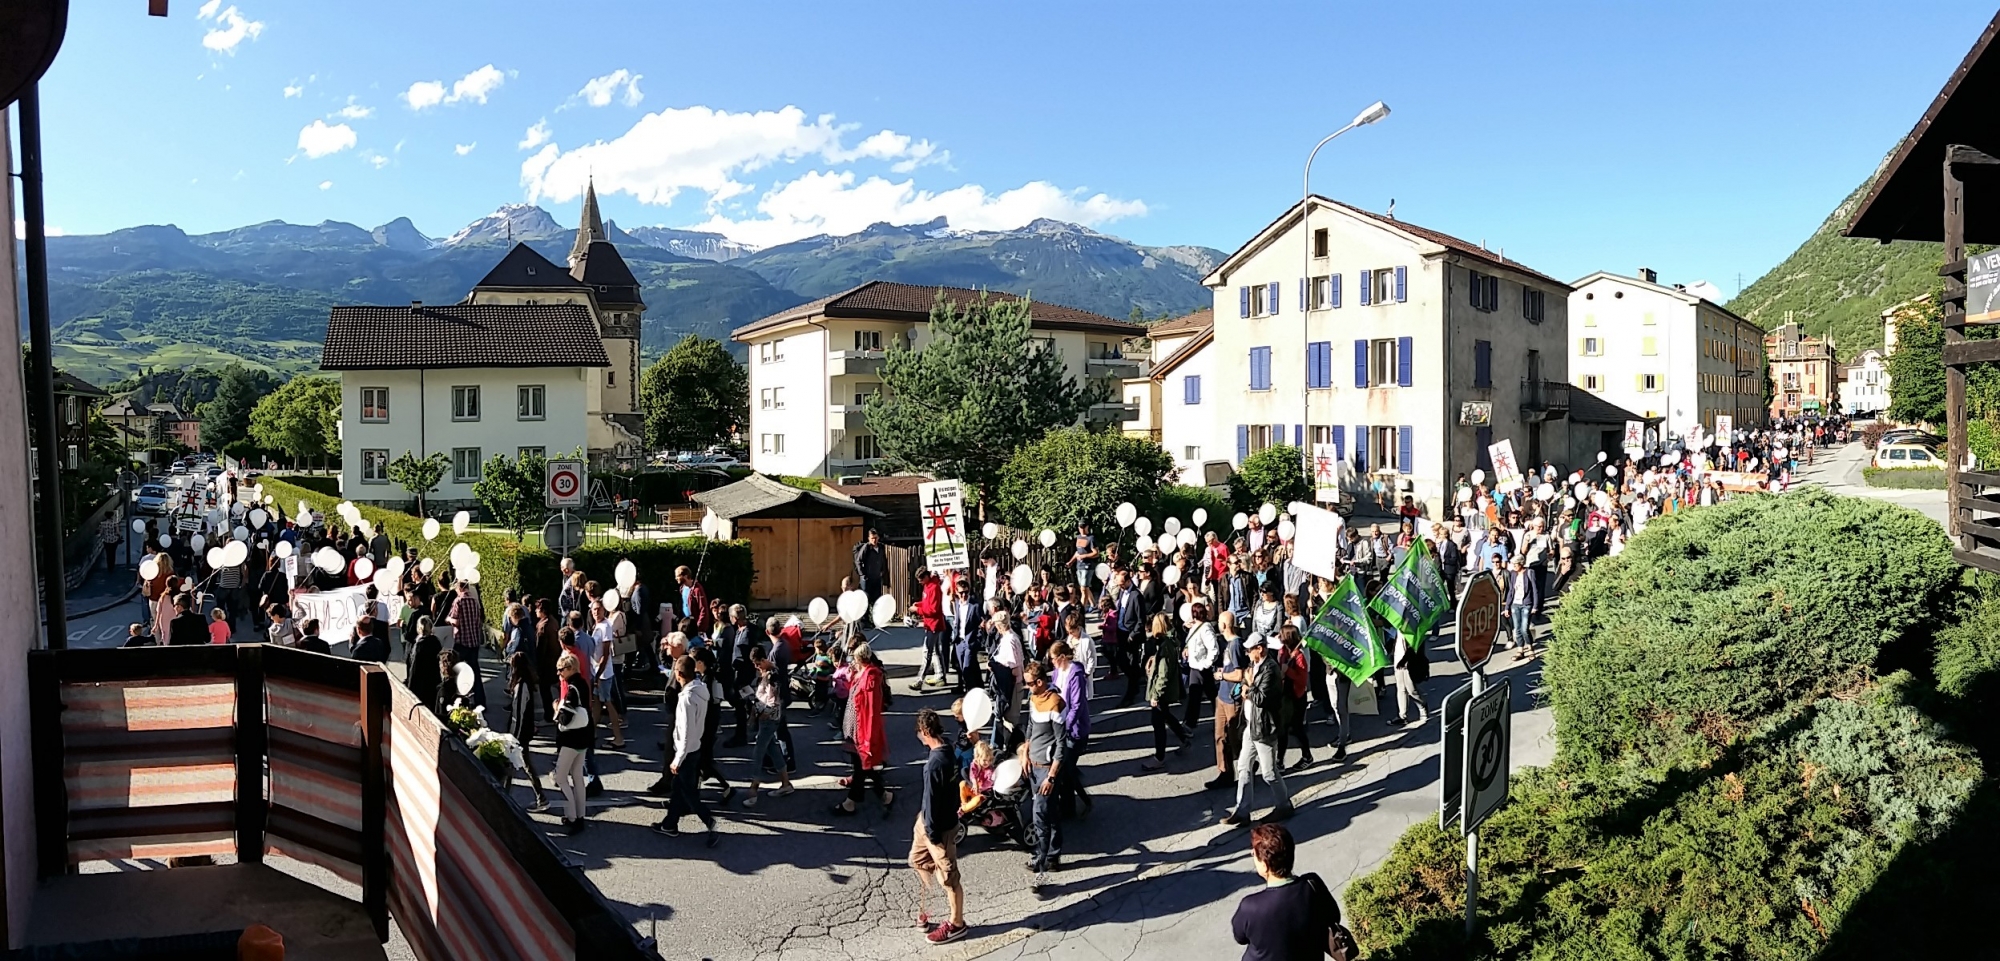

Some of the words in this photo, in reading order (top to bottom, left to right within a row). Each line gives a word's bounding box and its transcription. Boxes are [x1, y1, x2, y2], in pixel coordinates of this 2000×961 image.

[1973, 259, 1980, 273] A
[559, 479, 571, 489] 30
[1465, 603, 1495, 641] STOP
[1480, 698, 1498, 722] ZONE
[1481, 742, 1493, 764] 30
